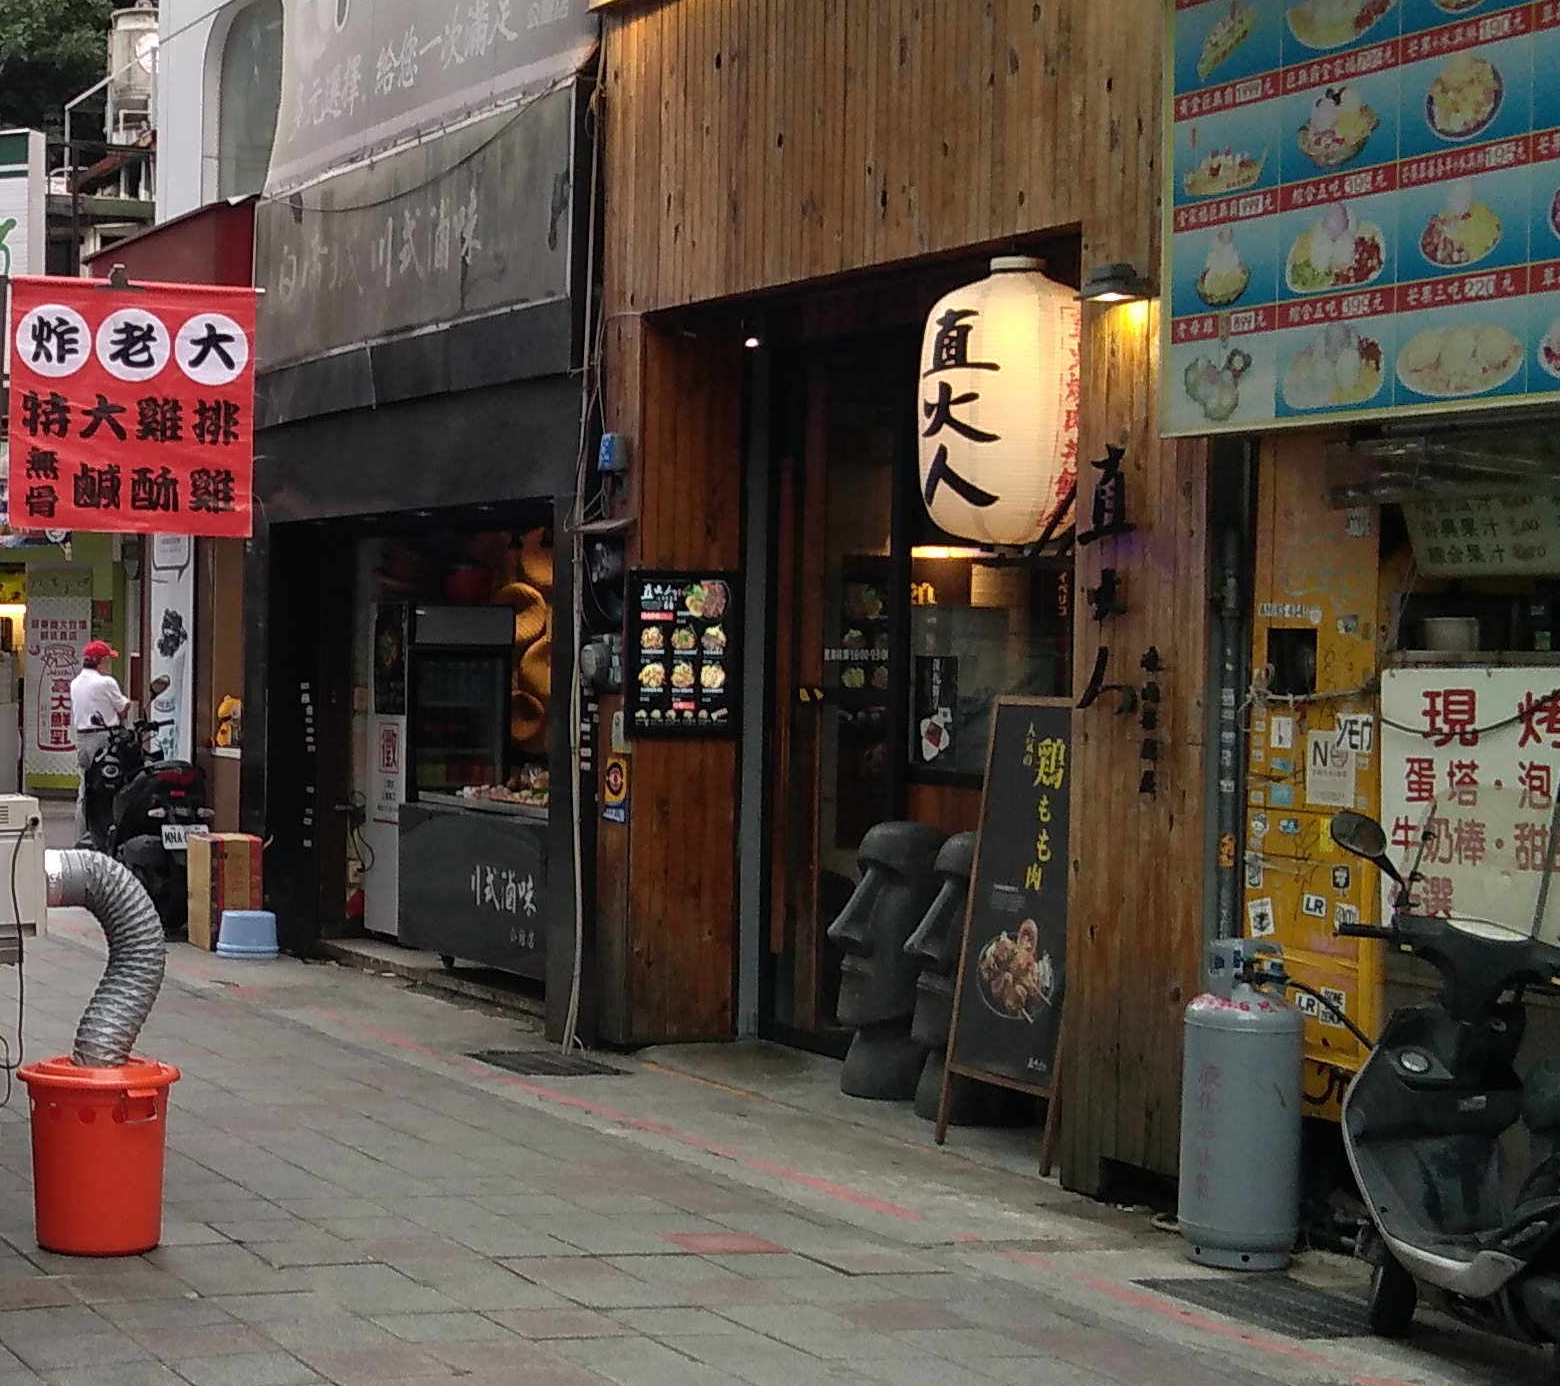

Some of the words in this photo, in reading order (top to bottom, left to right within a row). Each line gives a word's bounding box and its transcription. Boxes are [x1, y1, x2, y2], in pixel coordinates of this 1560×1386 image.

[29, 305, 237, 372] 炸老大
[21, 393, 241, 447] 特大雞排
[922, 307, 1003, 509] 直火人
[1306, 895, 1325, 915] LR
